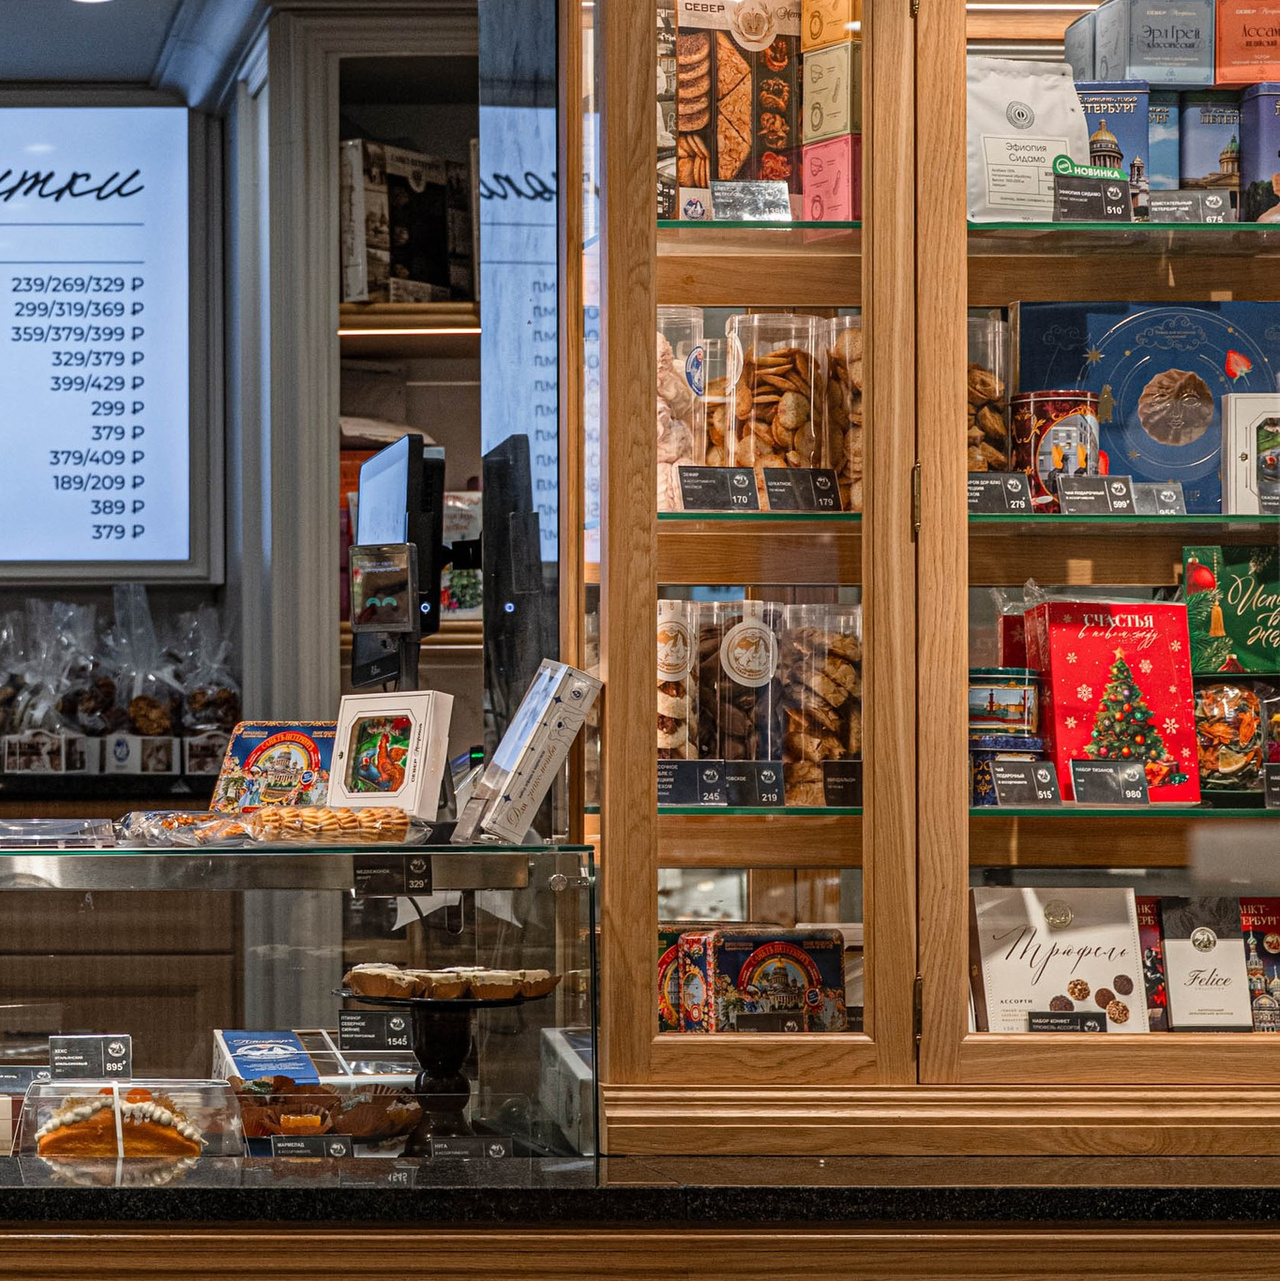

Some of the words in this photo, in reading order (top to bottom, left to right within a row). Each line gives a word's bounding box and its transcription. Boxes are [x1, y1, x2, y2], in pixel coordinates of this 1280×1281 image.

[685, 2, 725, 13] СЕВЕР
[1006, 141, 1047, 153] Эфиопия
[1009, 153, 1046, 163] Сидамо
[1074, 166, 1120, 178] НОВИНКА
[1107, 207, 1122, 215] 510
[1206, 215, 1223, 223] 675
[11, 276, 124, 293] 239/269/329
[14, 300, 124, 318] 299/319/369
[11, 325, 124, 342] 359/379/399
[52, 350, 125, 367] 329/379
[50, 375, 125, 392] 399/429
[91, 401, 125, 416] 299
[91, 426, 125, 440] 379
[49, 449, 125, 466] 379/409
[53, 474, 125, 491] 189/209
[732, 496, 748, 504] 170
[819, 498, 834, 506] 179
[1010, 501, 1025, 509] 279
[90, 500, 125, 514] 389
[92, 525, 125, 539] 379
[1084, 613, 1154, 628] СЧАСТЬЯ
[703, 792, 720, 801] 245
[762, 793, 778, 802] 219
[1038, 790, 1052, 799] 515
[1125, 790, 1142, 799] 980
[992, 923, 1129, 986] Трюфель
[1183, 968, 1232, 987] Felice
[387, 1037, 407, 1046] 1545
[106, 1063, 123, 1071] 895
